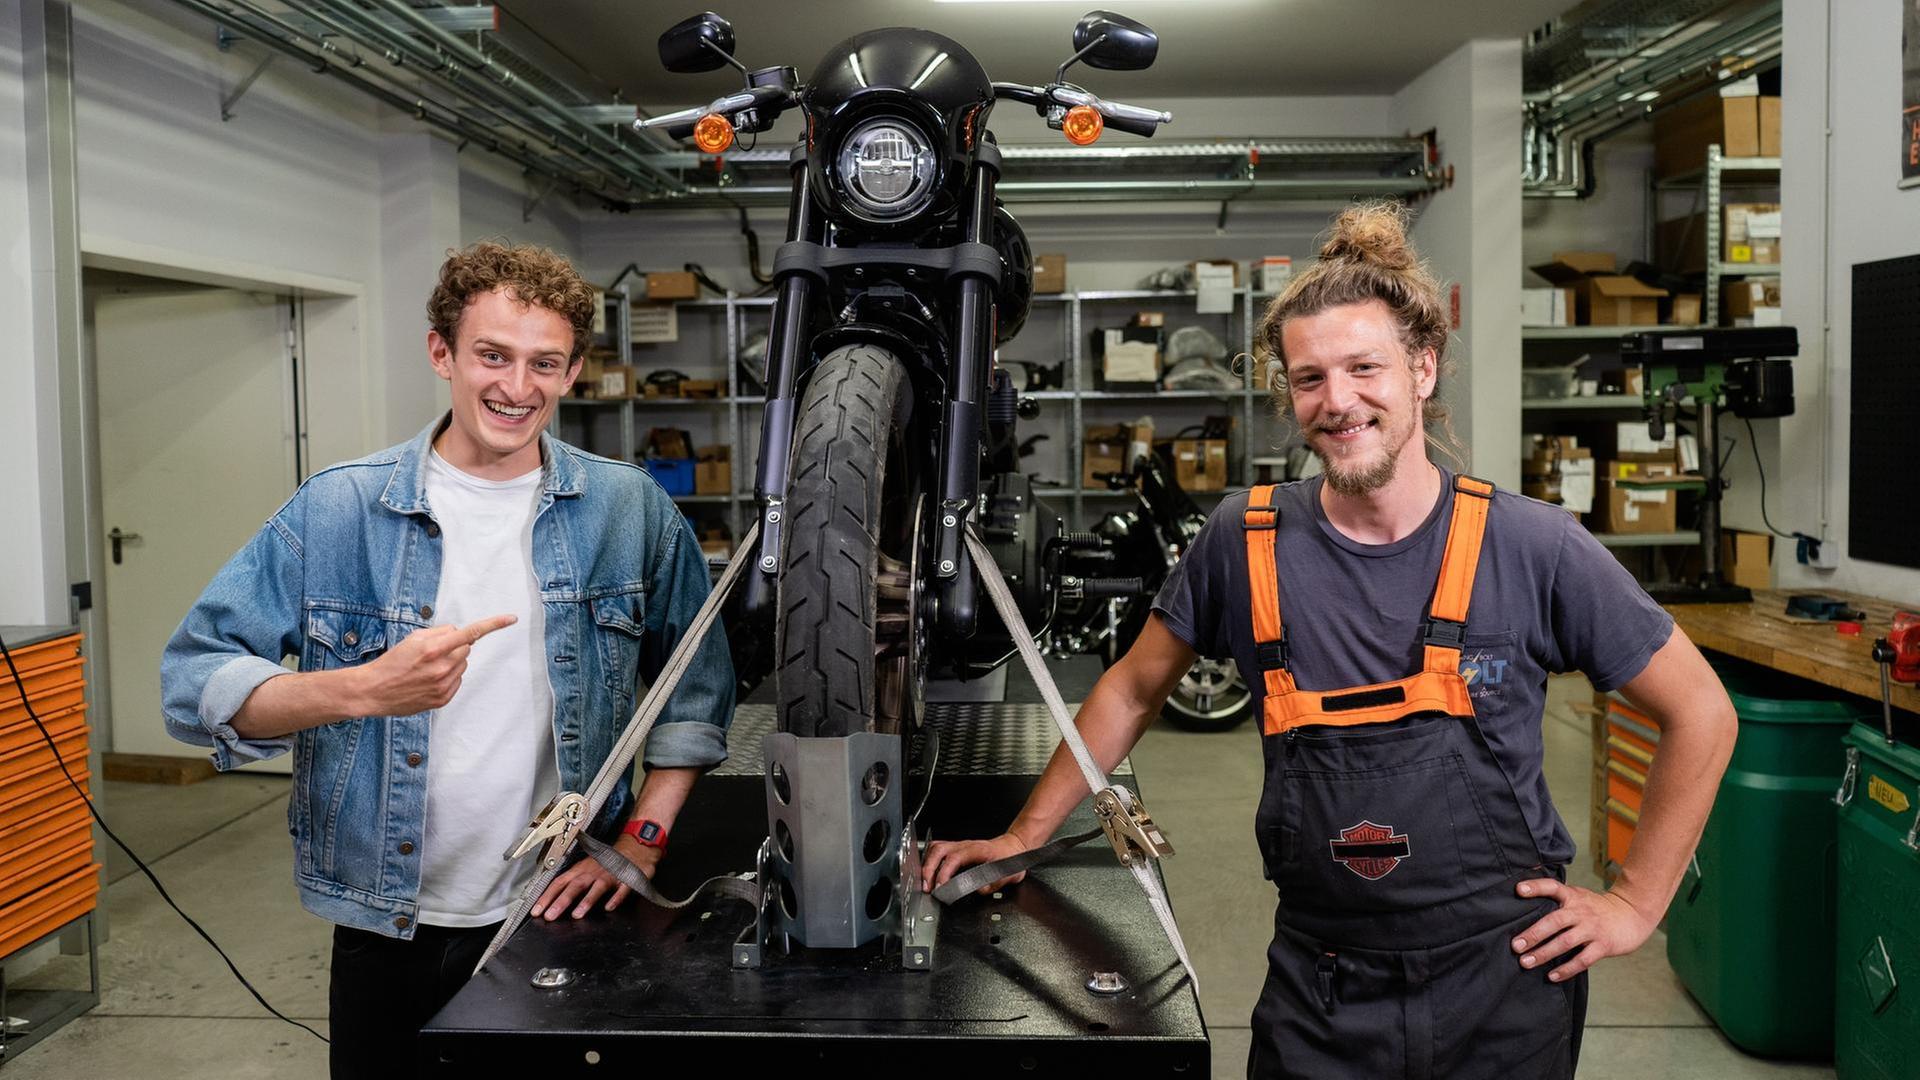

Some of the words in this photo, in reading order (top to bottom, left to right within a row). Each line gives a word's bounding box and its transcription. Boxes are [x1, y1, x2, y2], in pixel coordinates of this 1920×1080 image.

[1460, 660, 1507, 684] OLT
[1349, 829, 1385, 843] MOTOR
[1351, 859, 1392, 875] CYCLES
